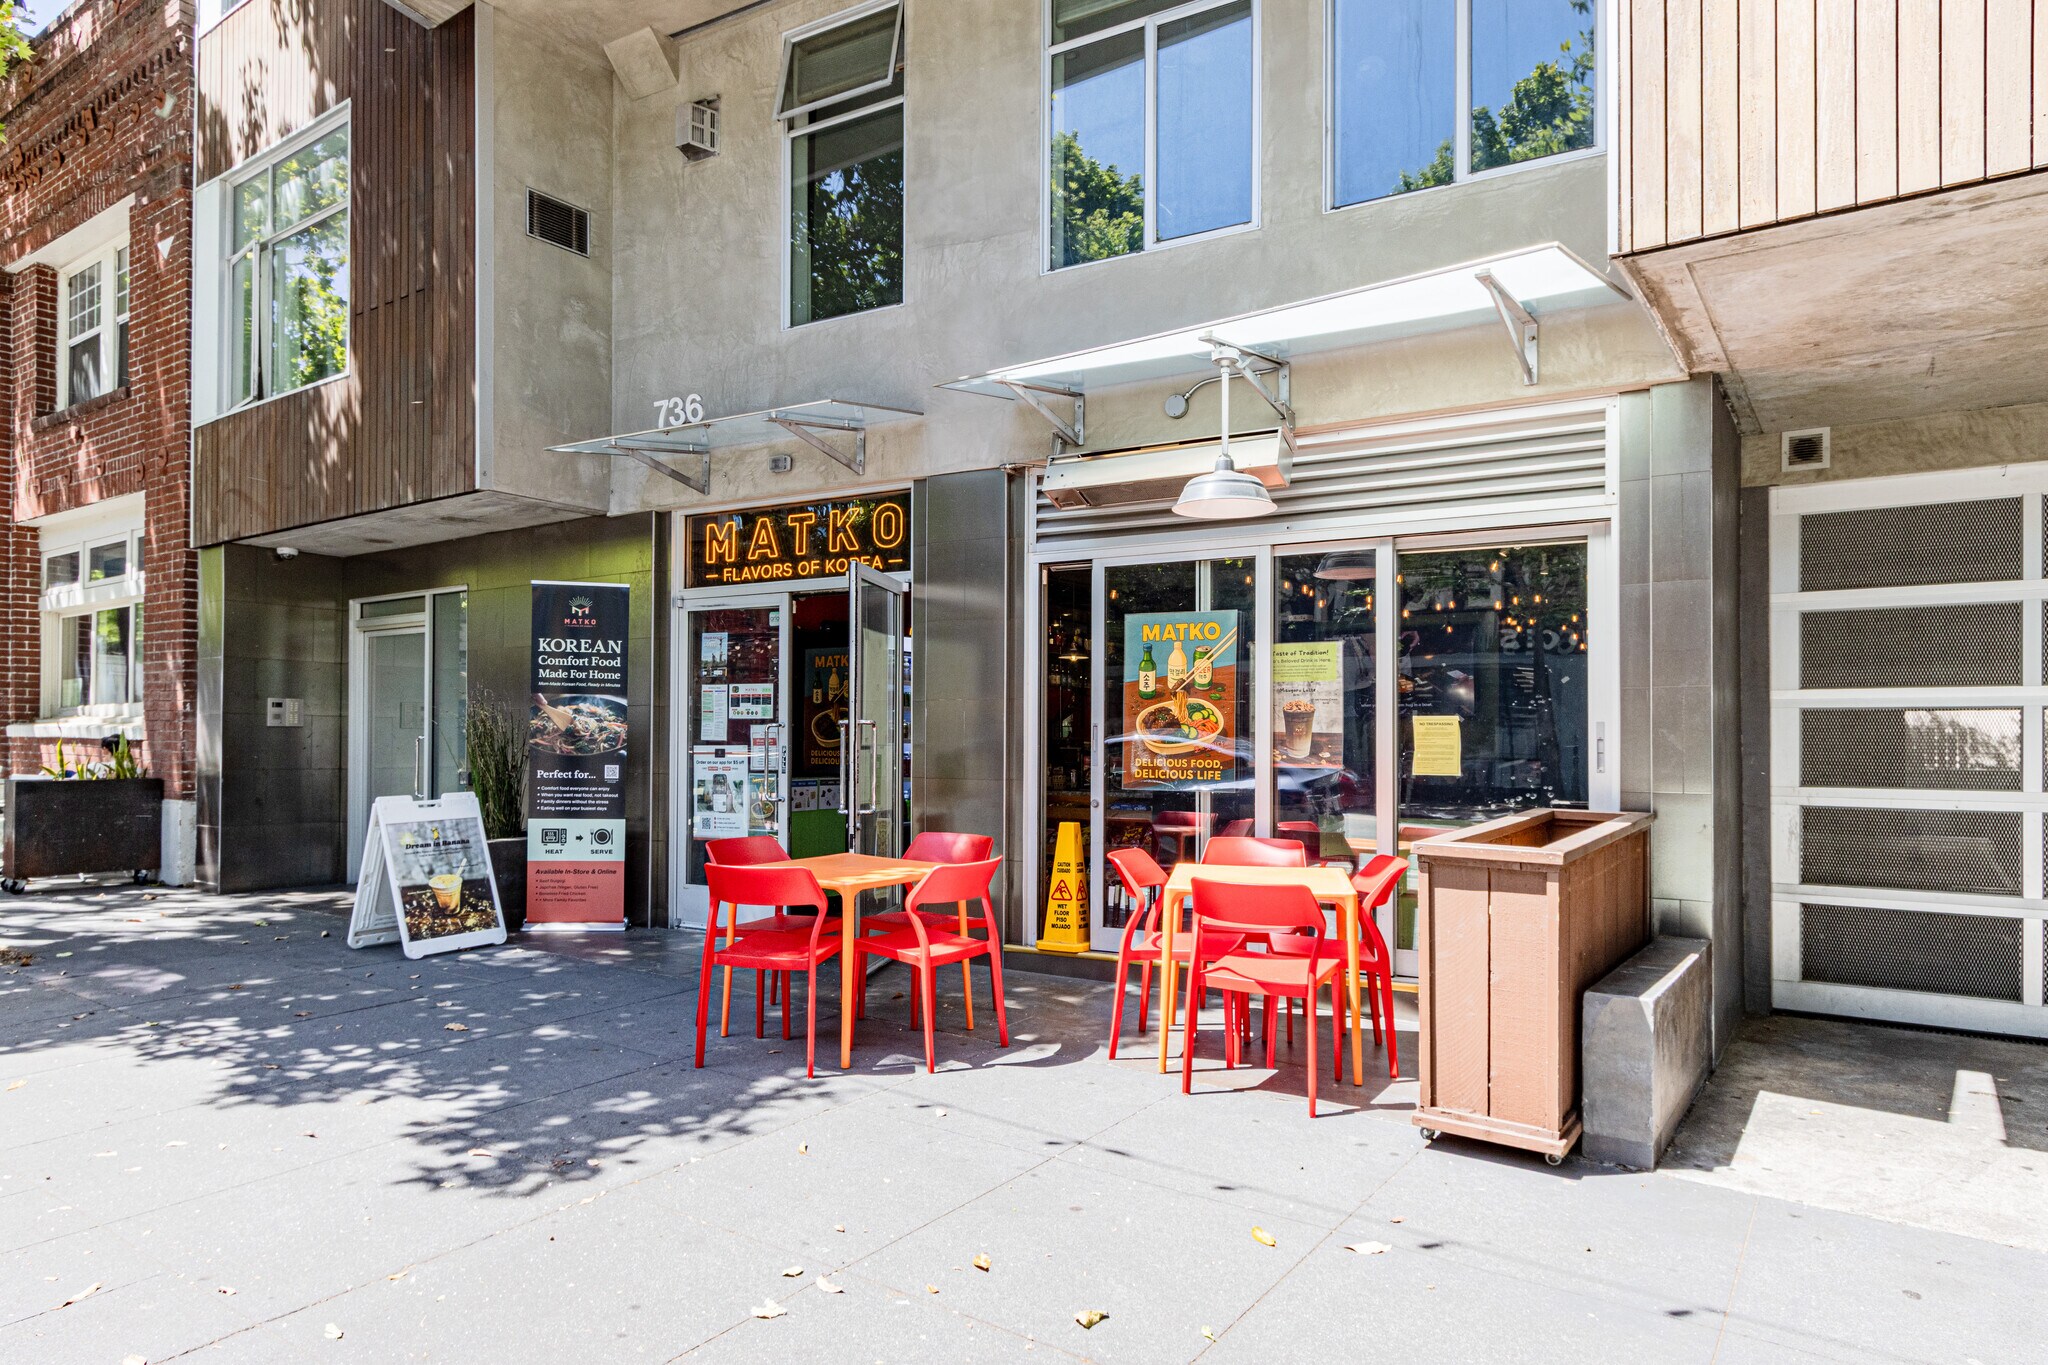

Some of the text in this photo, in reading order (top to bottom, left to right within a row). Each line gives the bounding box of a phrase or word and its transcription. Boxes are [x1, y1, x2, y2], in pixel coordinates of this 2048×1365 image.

[653, 393, 703, 428] 736
[706, 503, 903, 564] MATKO
[723, 562, 793, 582] FLAVORS
[798, 560, 820, 576] OF
[1142, 621, 1221, 642] MATKO
[537, 638, 622, 654] KOREAN
[538, 655, 621, 667] Comfort Food
[538, 669, 621, 680] Made For Home
[1143, 673, 1150, 690] 소주
[1135, 758, 1223, 770] DELICIOUS FOOD,
[536, 769, 596, 779] Perfect for...
[1134, 769, 1222, 780] DELICIOUS LIFE
[442, 839, 470, 847] Banana
